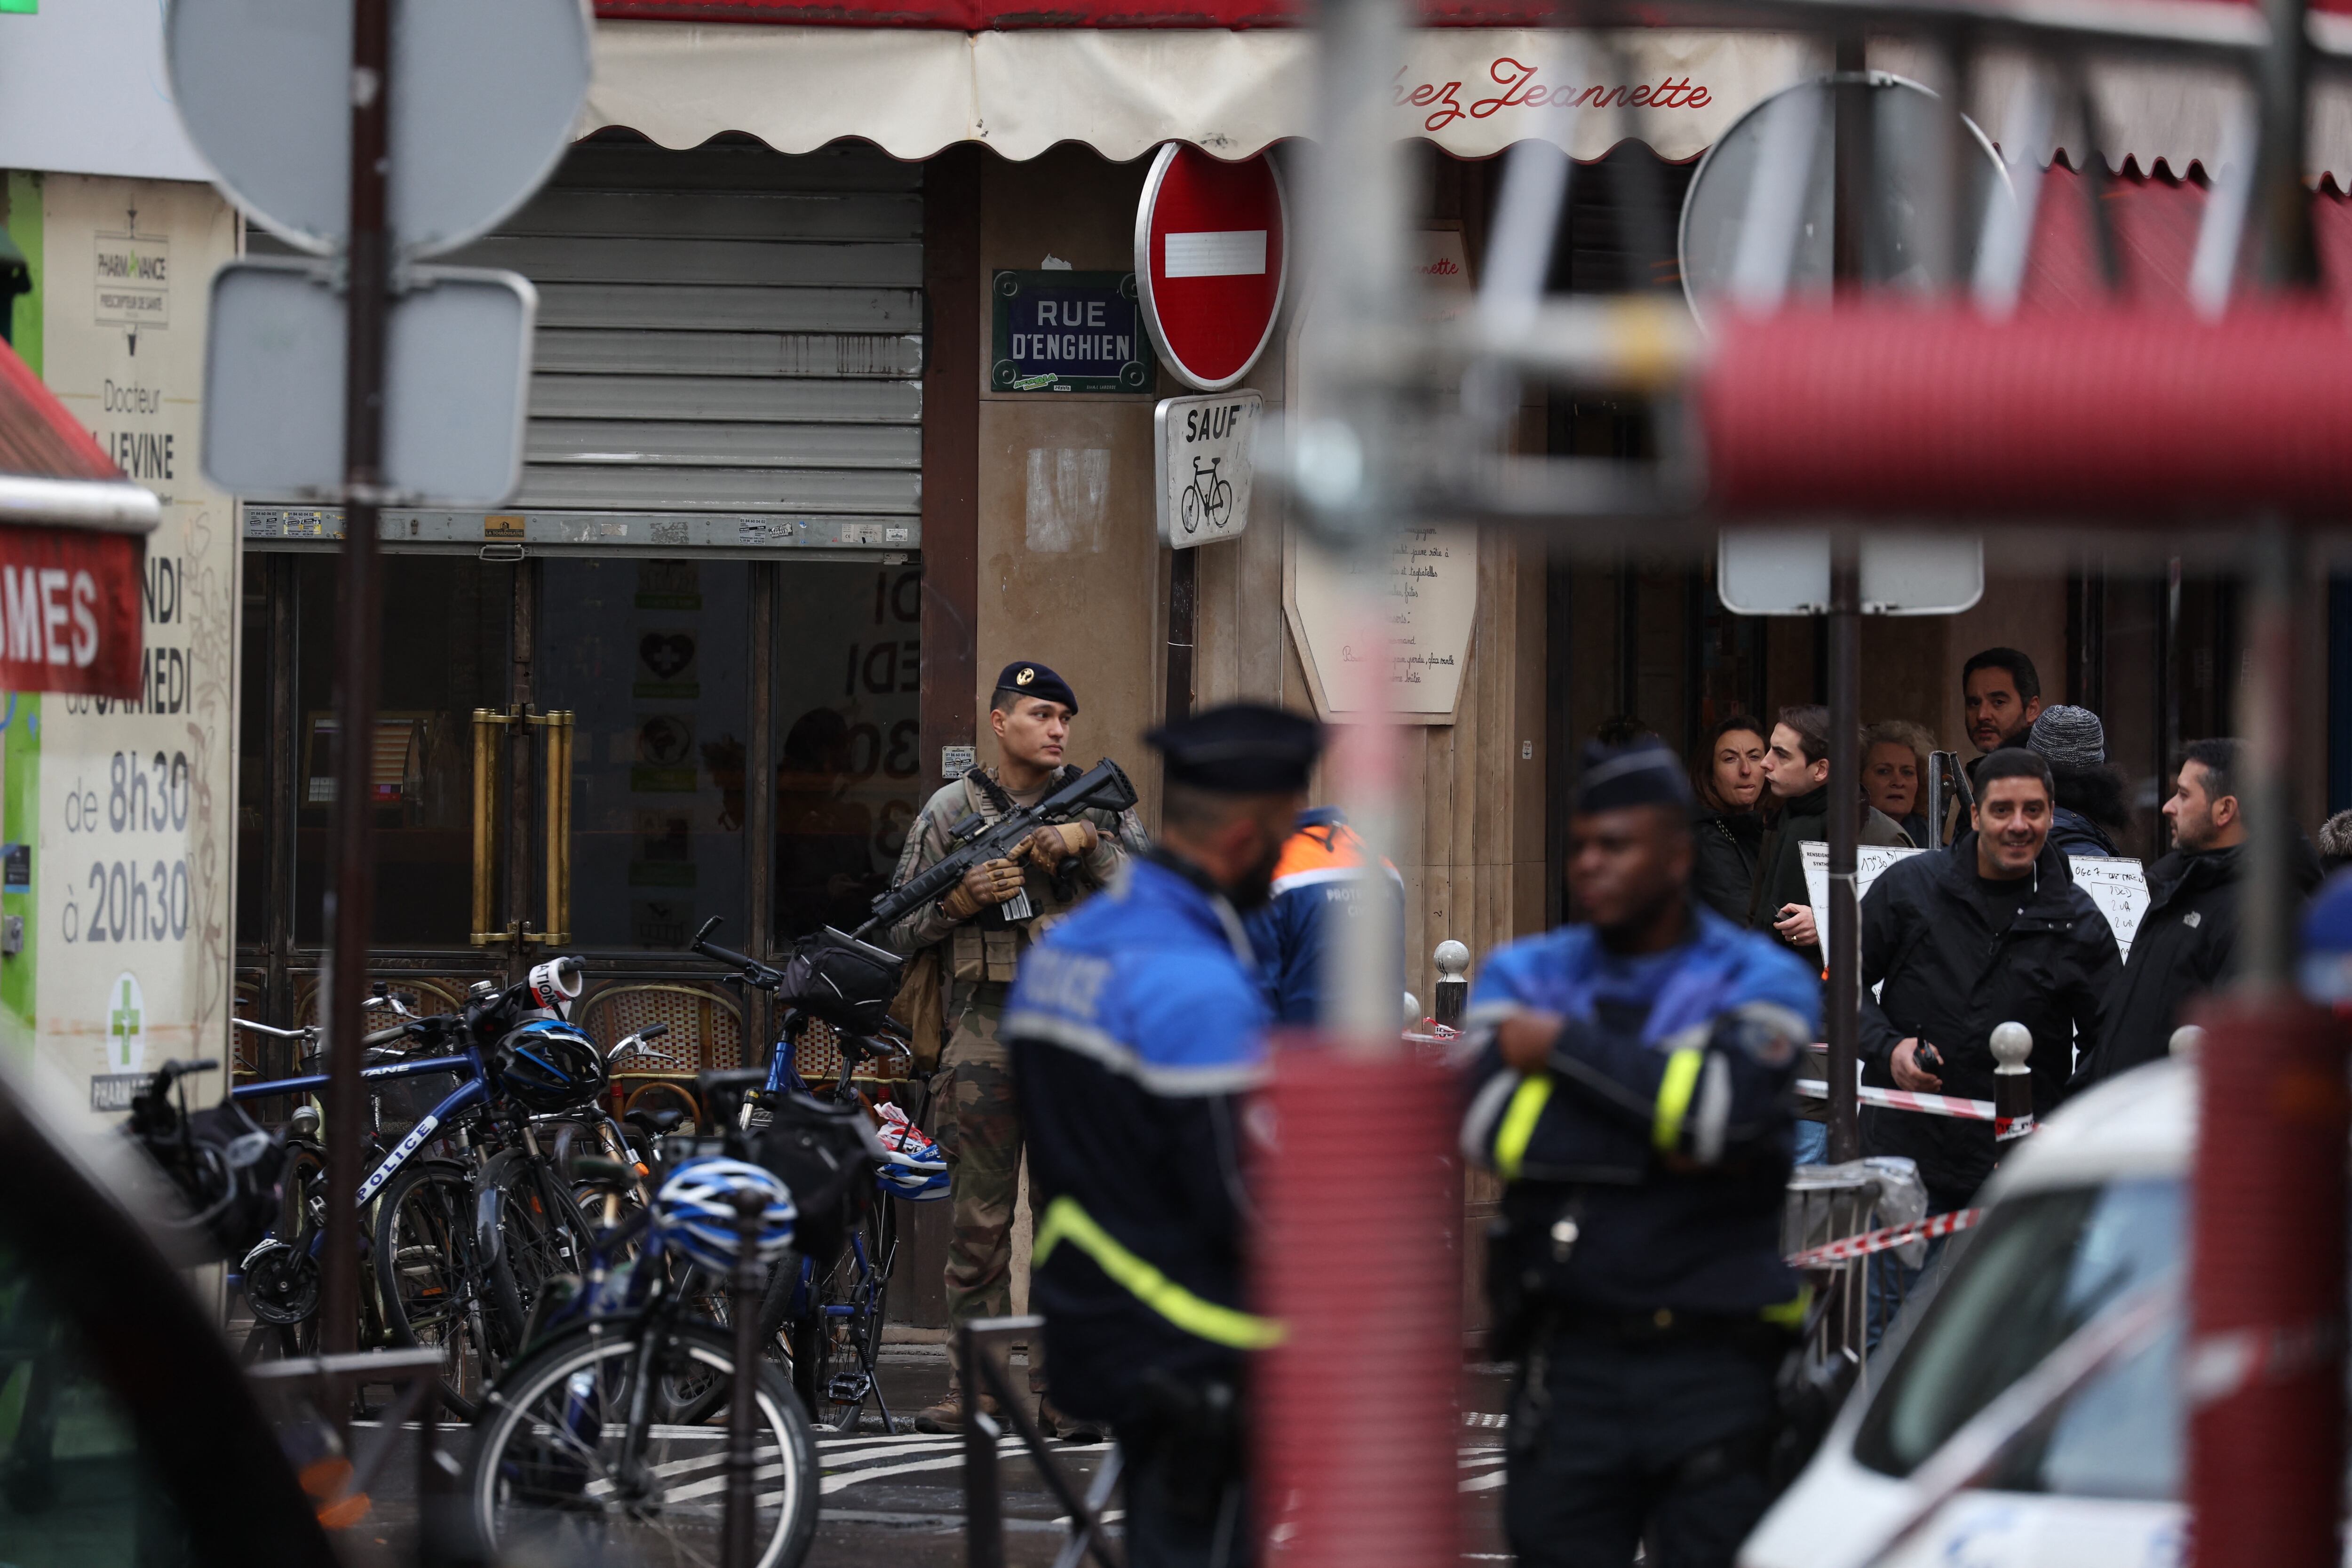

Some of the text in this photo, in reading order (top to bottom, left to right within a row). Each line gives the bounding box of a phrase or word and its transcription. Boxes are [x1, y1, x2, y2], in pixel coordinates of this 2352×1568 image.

[1391, 57, 1712, 132] hez Jeannette
[1038, 301, 1105, 326] RUE
[1013, 334, 1129, 360] D'ENGHIEN
[104, 379, 160, 414] Docteur
[1186, 405, 1240, 443] SAUF
[1411, 546, 1427, 563] jaune
[142, 557, 182, 624] NDI
[1409, 565, 1438, 582] tagliatelles
[1404, 582, 1418, 603] frites
[0, 567, 98, 668] MES
[1405, 669, 1421, 683] brûlée
[65, 751, 188, 833] de 8h30
[63, 860, 189, 943] à 20h30
[359, 1064, 411, 1077] TANE
[357, 1123, 430, 1201] POLICE
